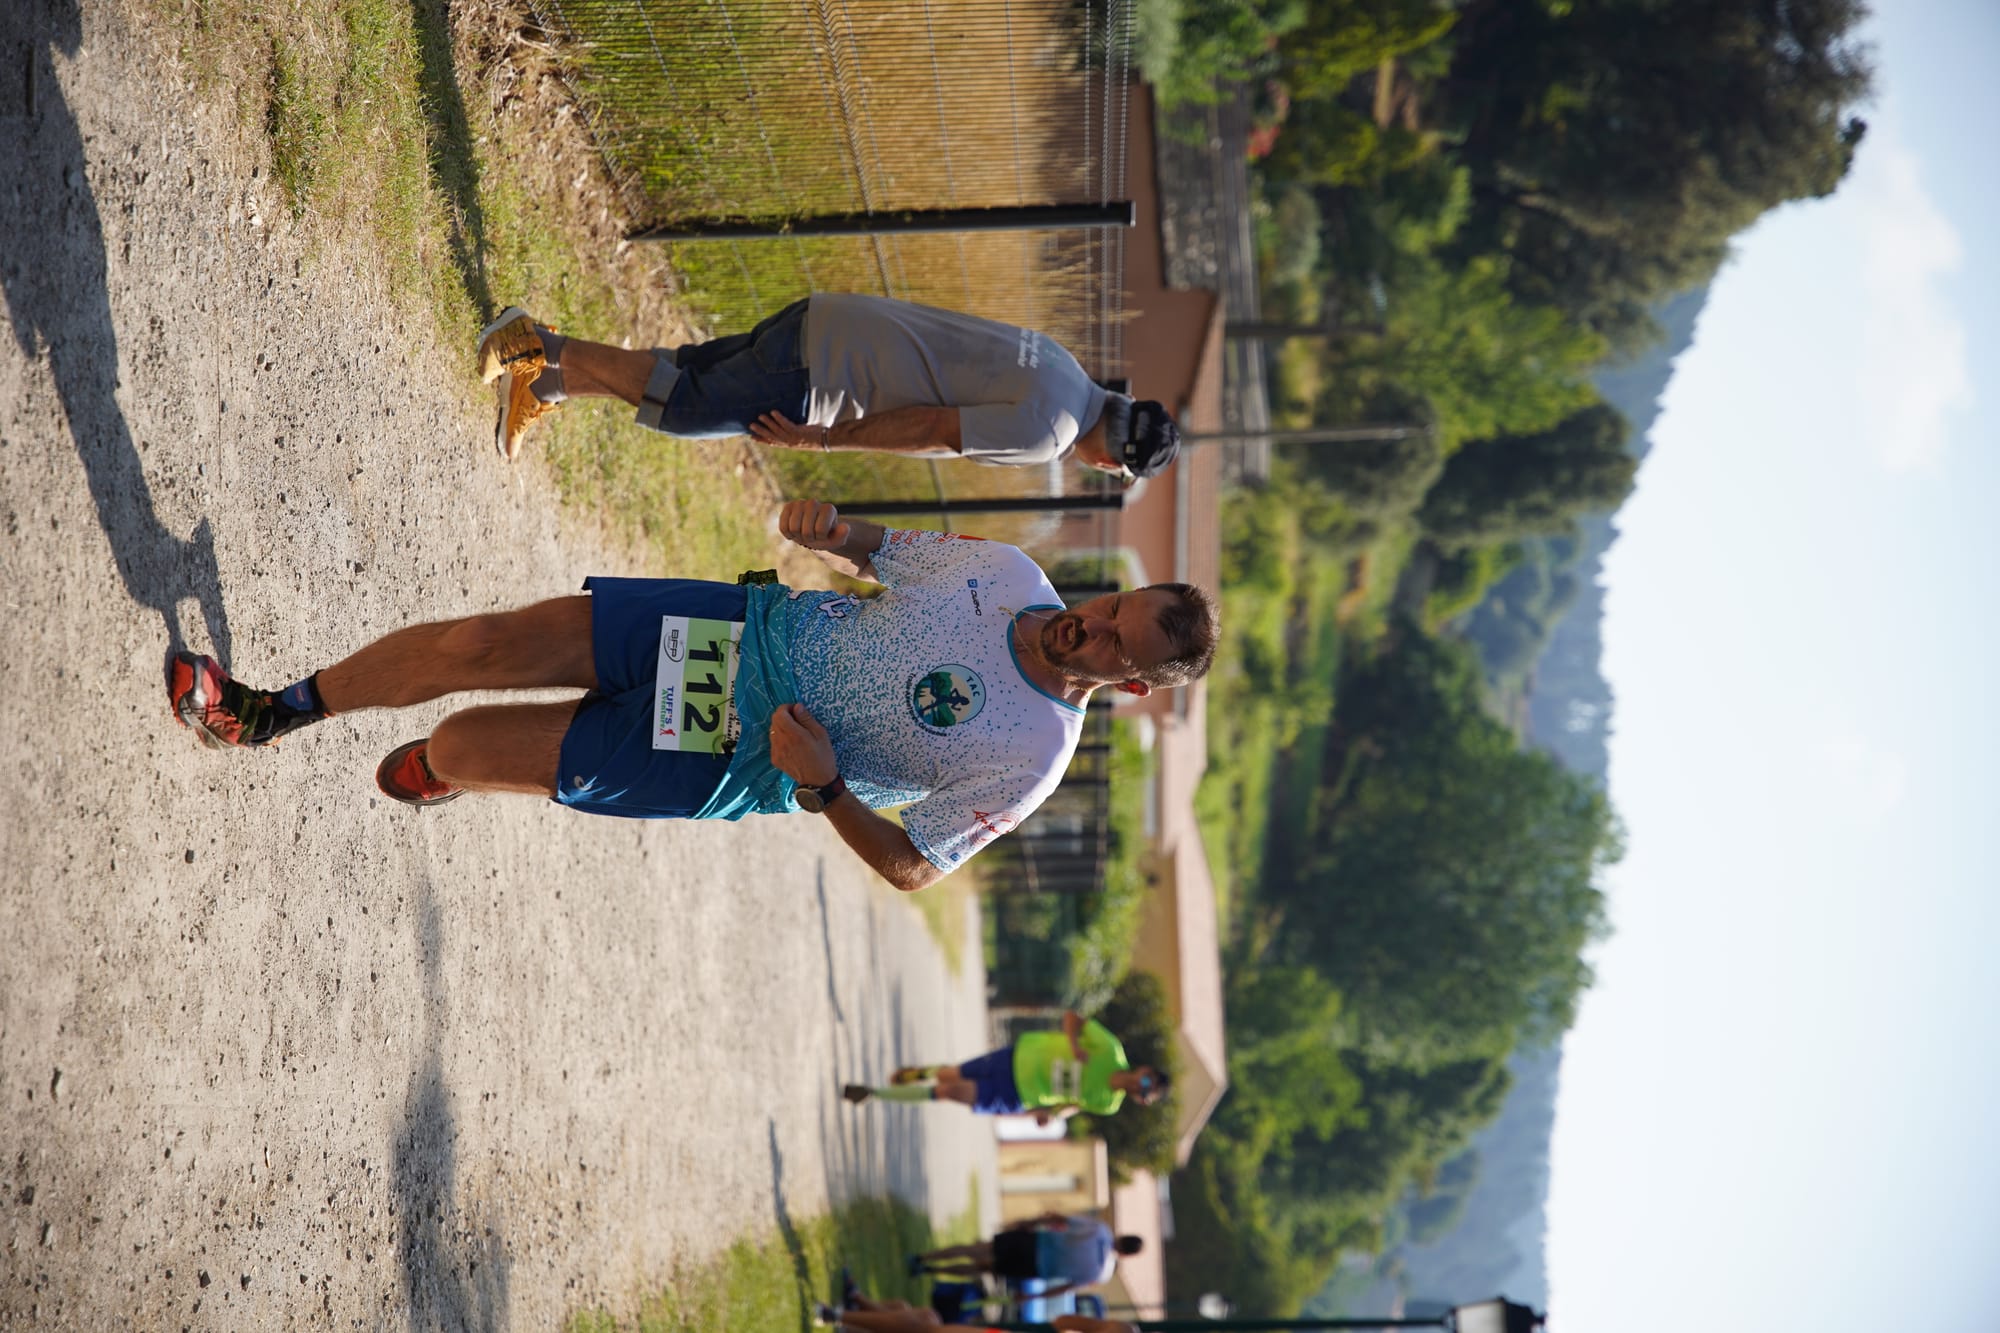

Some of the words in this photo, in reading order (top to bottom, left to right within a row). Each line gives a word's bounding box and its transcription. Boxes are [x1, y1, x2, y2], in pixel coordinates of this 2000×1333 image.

[670, 629, 680, 658] BFP
[665, 686, 674, 724] TUFF'S
[684, 640, 724, 732] 112
[966, 676, 980, 696] TAC
[660, 688, 668, 728] Aventure
